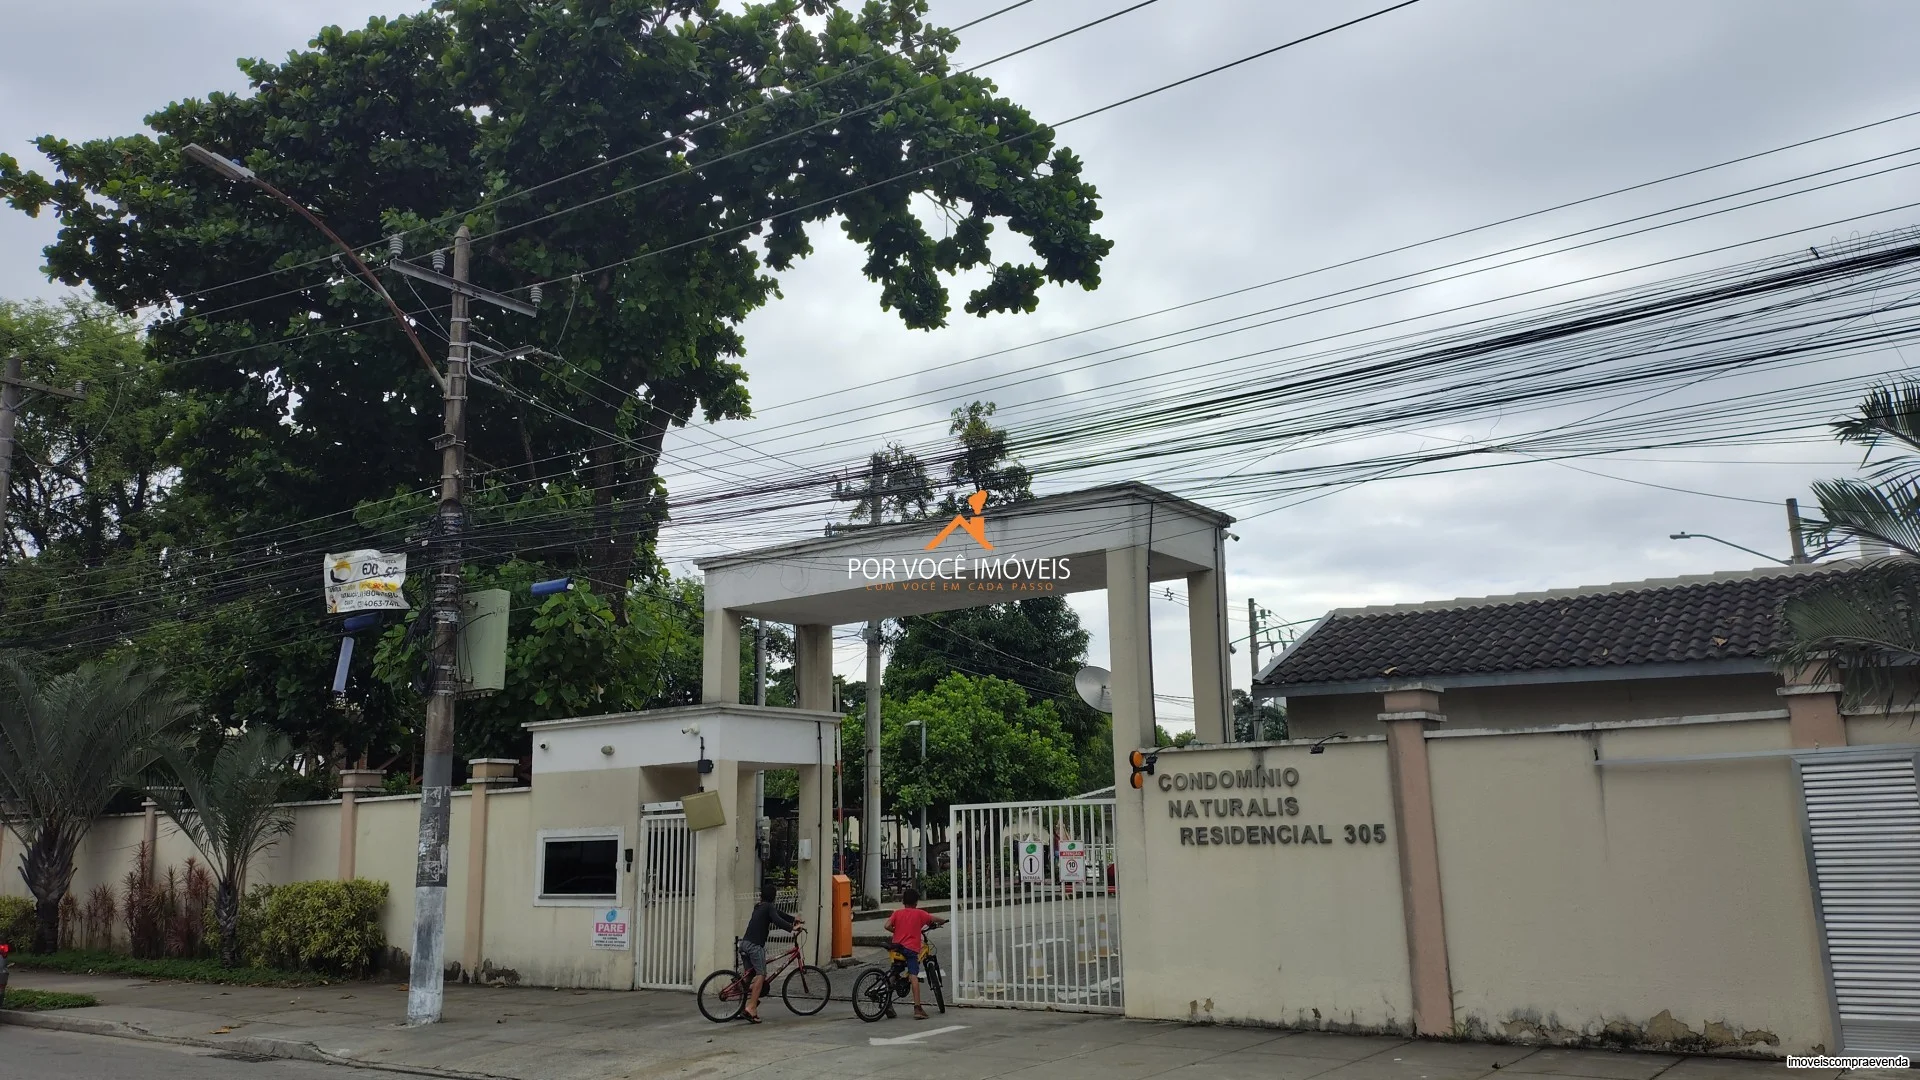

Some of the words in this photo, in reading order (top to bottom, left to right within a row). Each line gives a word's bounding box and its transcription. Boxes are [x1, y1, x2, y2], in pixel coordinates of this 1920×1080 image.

[1158, 764, 1299, 792] CONDOMÍNIO
[1168, 796, 1300, 818] NATURALIS
[1180, 824, 1332, 845] RESIDENCIAL
[1343, 823, 1387, 844] 305
[598, 923, 623, 932] PARE
